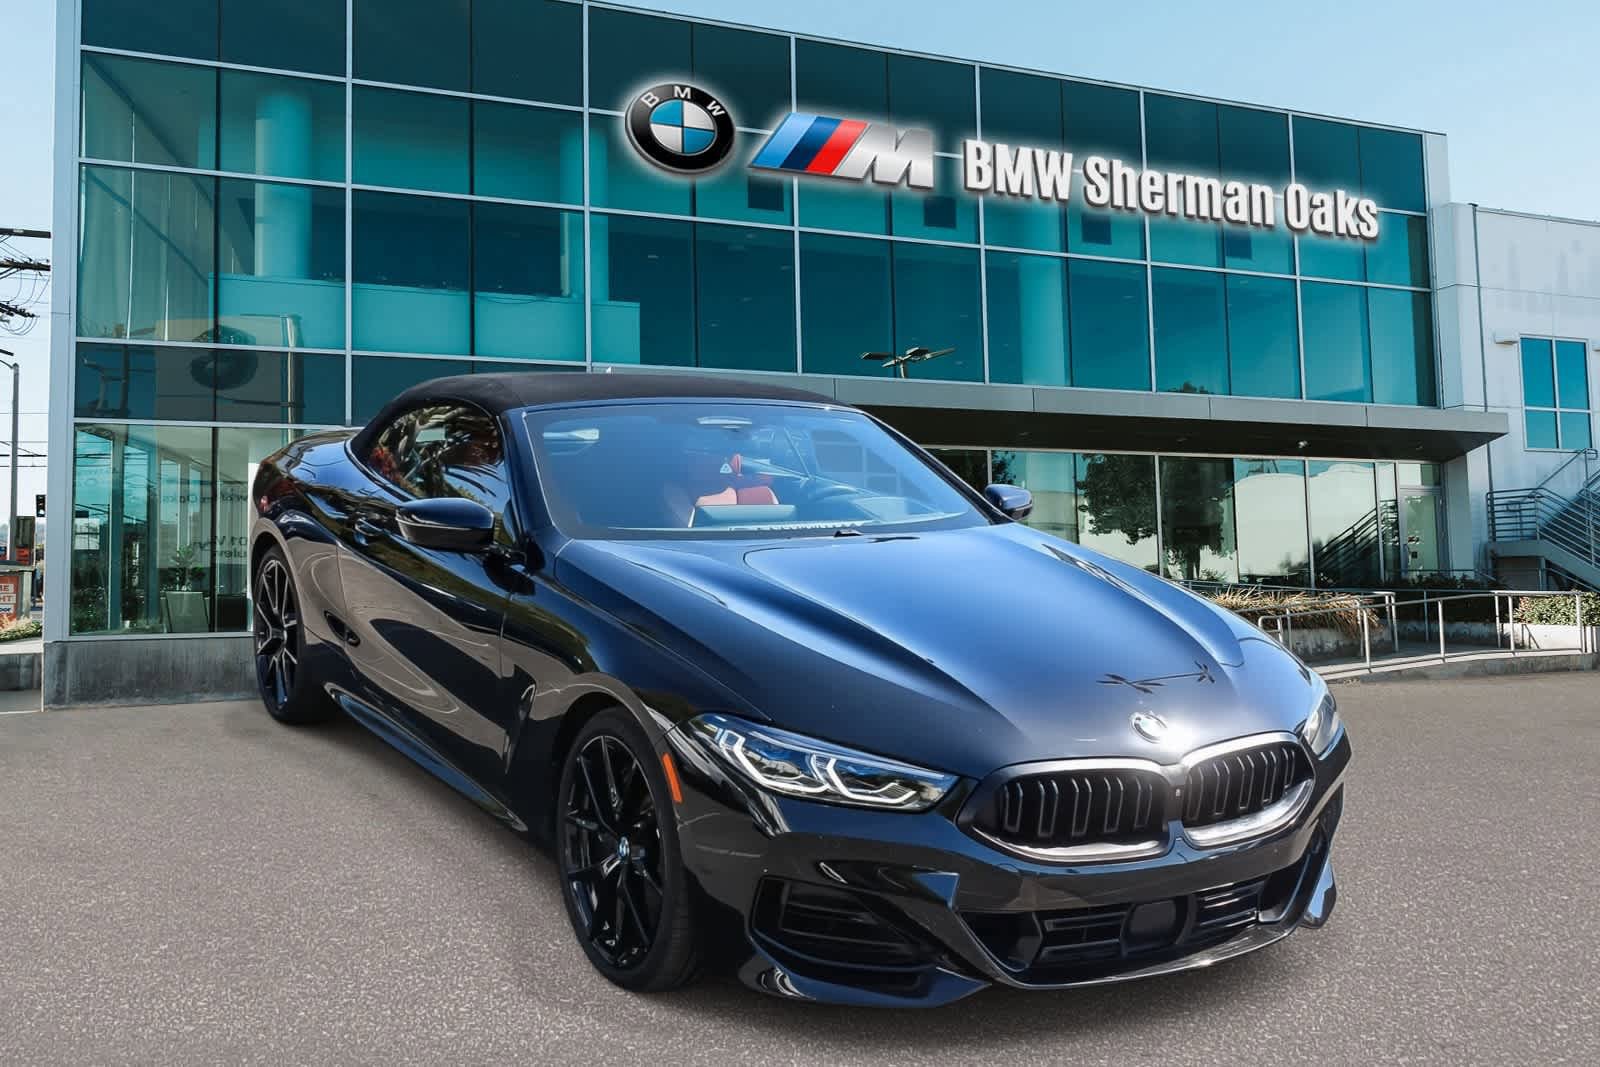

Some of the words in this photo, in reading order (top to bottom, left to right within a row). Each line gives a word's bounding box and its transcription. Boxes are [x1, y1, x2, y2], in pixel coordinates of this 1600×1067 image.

[963, 138, 1073, 202] BMW
[1083, 155, 1275, 227] Sherman
[1284, 182, 1380, 241] Oaks
